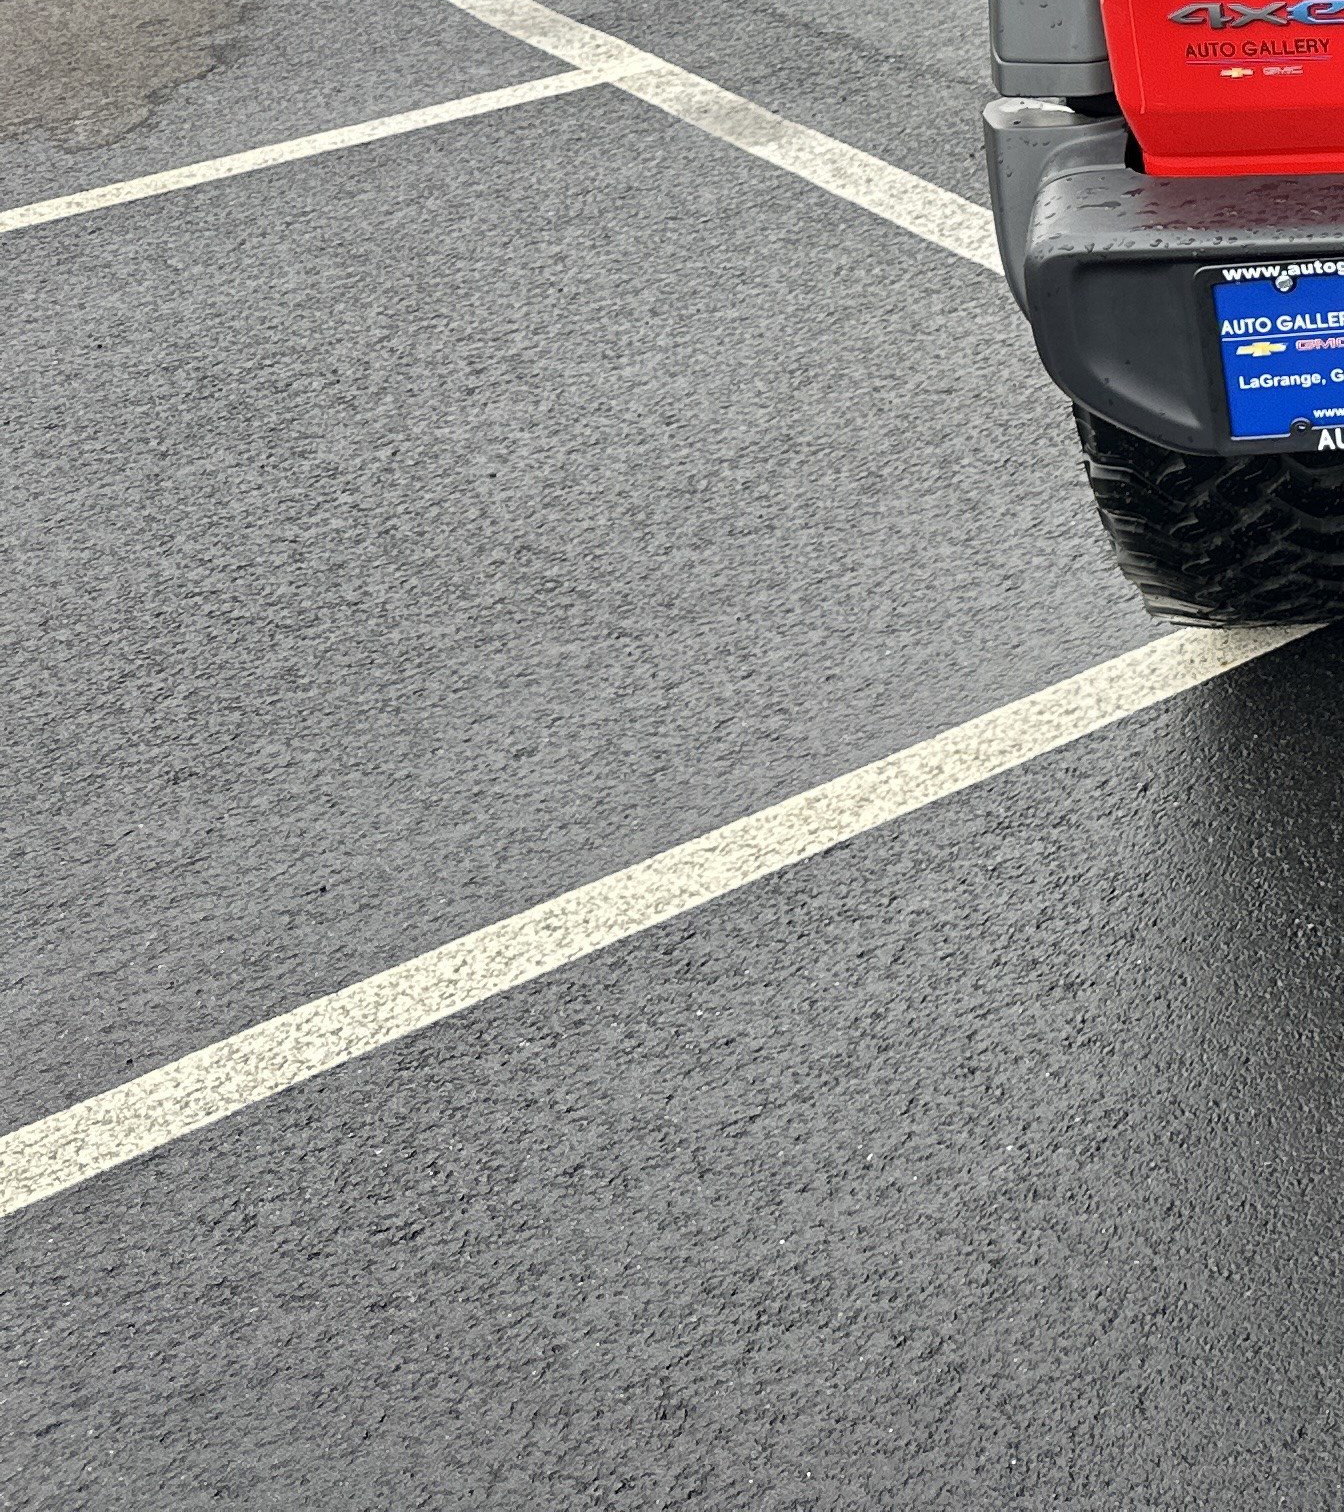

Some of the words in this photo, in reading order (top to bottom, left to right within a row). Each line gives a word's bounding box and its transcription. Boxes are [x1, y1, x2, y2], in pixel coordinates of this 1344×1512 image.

[1185, 41, 1236, 58] AUTO
[1242, 38, 1331, 56] GALLERY
[1221, 317, 1271, 336] AUTO
[1239, 370, 1326, 390] LaGrange,
